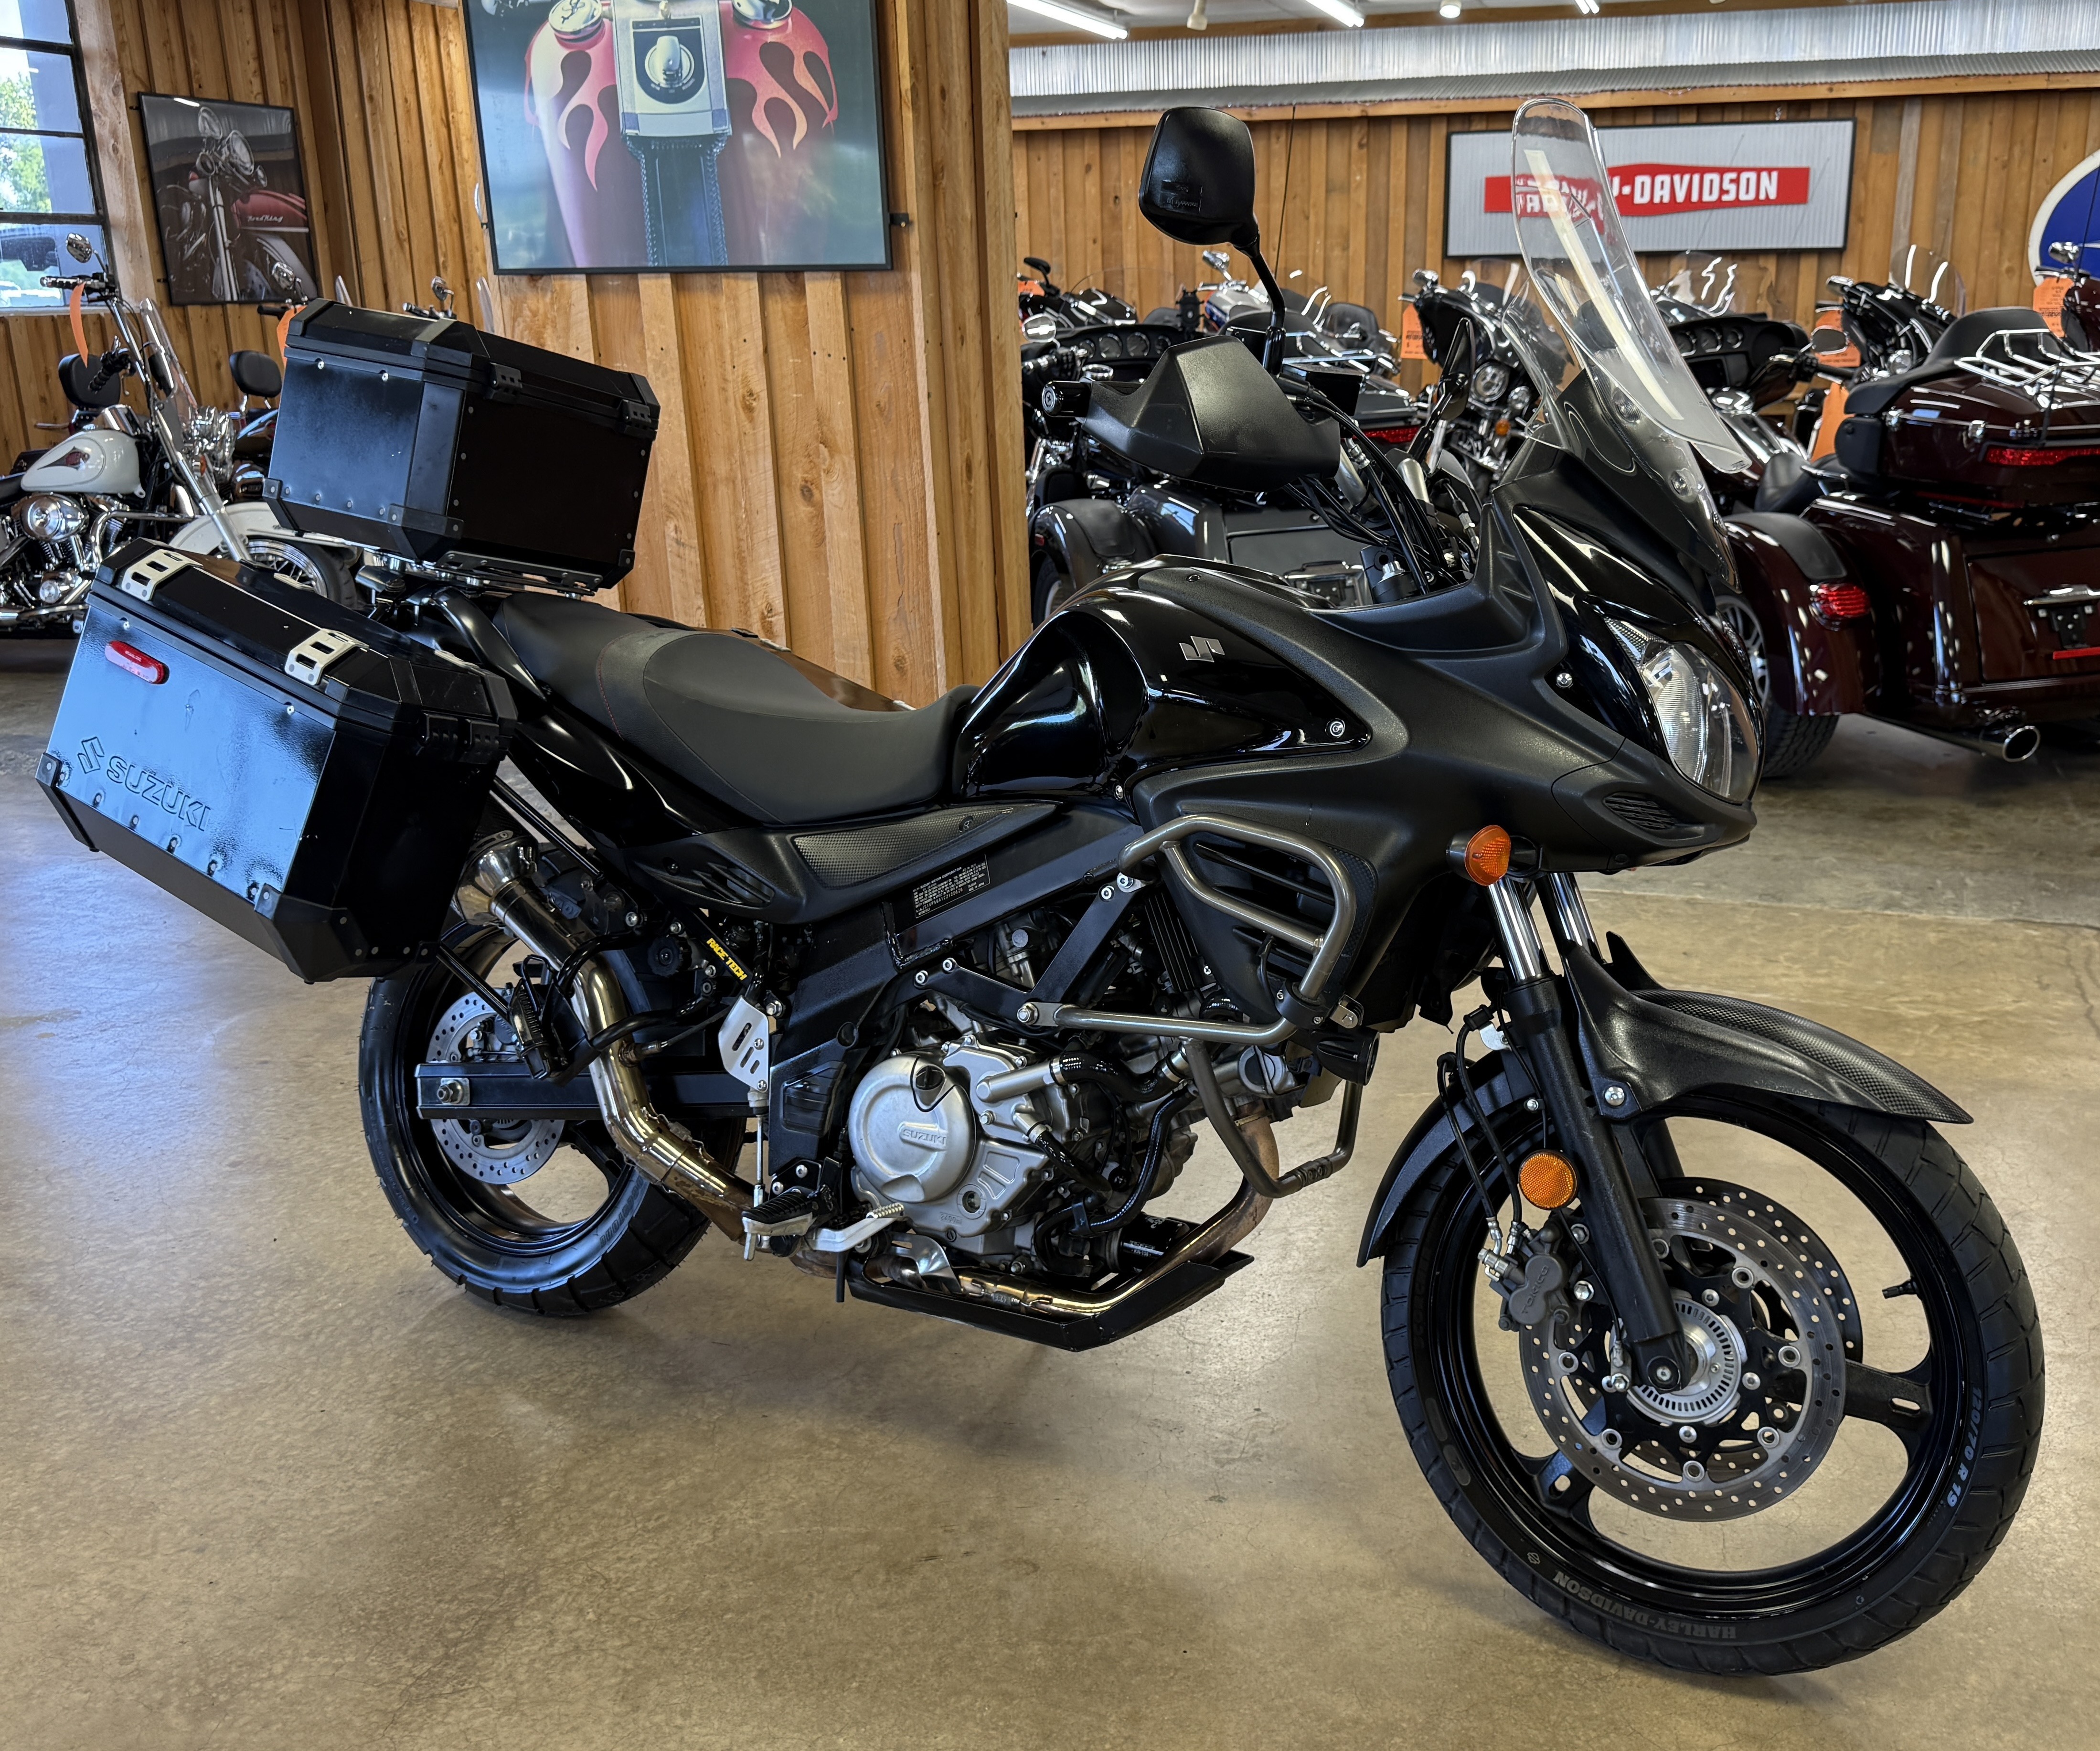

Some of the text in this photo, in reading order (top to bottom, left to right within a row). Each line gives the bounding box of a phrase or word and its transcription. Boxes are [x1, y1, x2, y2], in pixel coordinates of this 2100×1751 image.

[106, 756, 211, 832] SUZUKI
[706, 938, 747, 981] RACE TECH
[903, 1129, 947, 1145] SUZUKI
[599, 1175, 644, 1248] DGESTONE
[1521, 1265, 1549, 1314] TOKICO
[1947, 1386, 1982, 1507] 120/70 R 19
[1552, 1569, 1737, 1639] HARLEY-DAVIDSON
